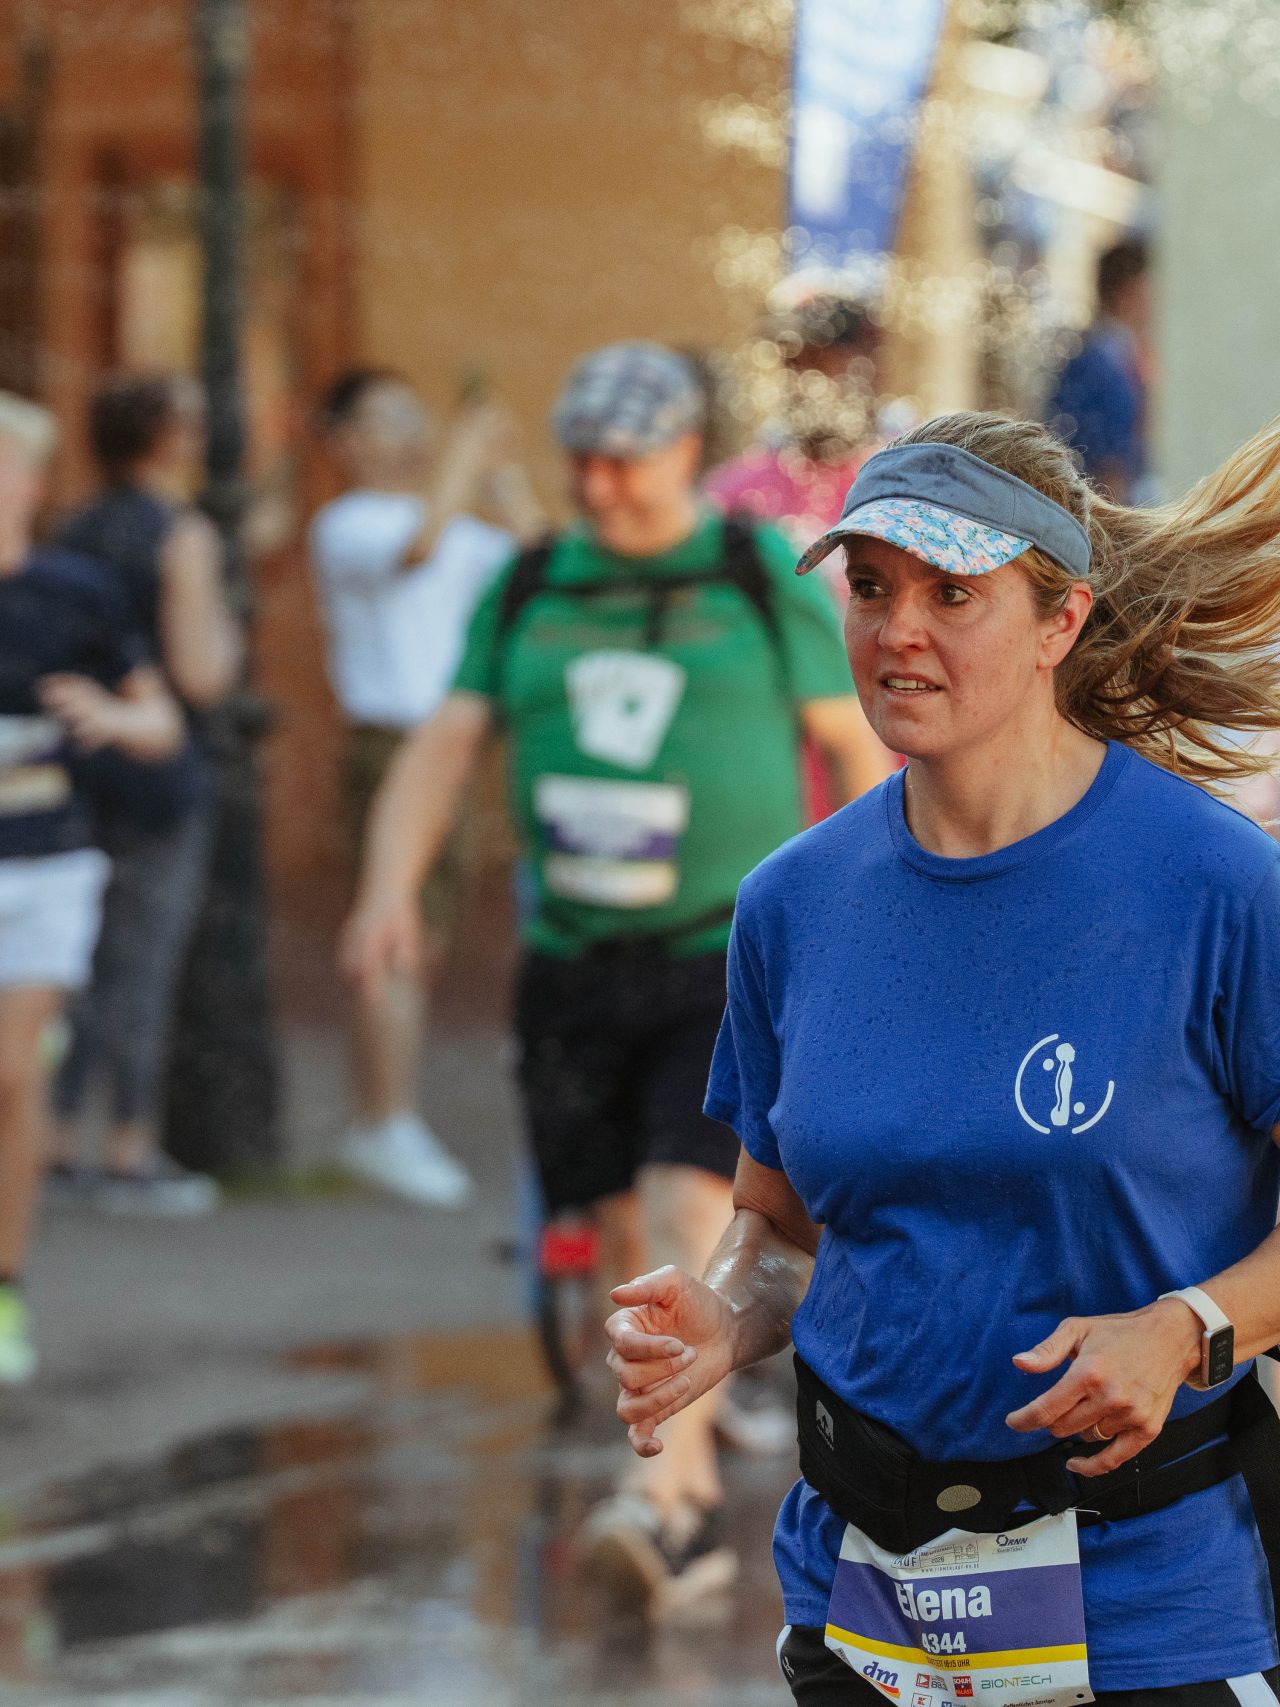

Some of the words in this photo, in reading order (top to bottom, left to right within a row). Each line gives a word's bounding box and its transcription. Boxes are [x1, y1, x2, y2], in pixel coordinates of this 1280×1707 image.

[894, 1581, 993, 1622] Elena
[921, 1631, 967, 1654] 4344
[863, 1661, 899, 1687] dm
[980, 1674, 1052, 1690] BIONTECH
